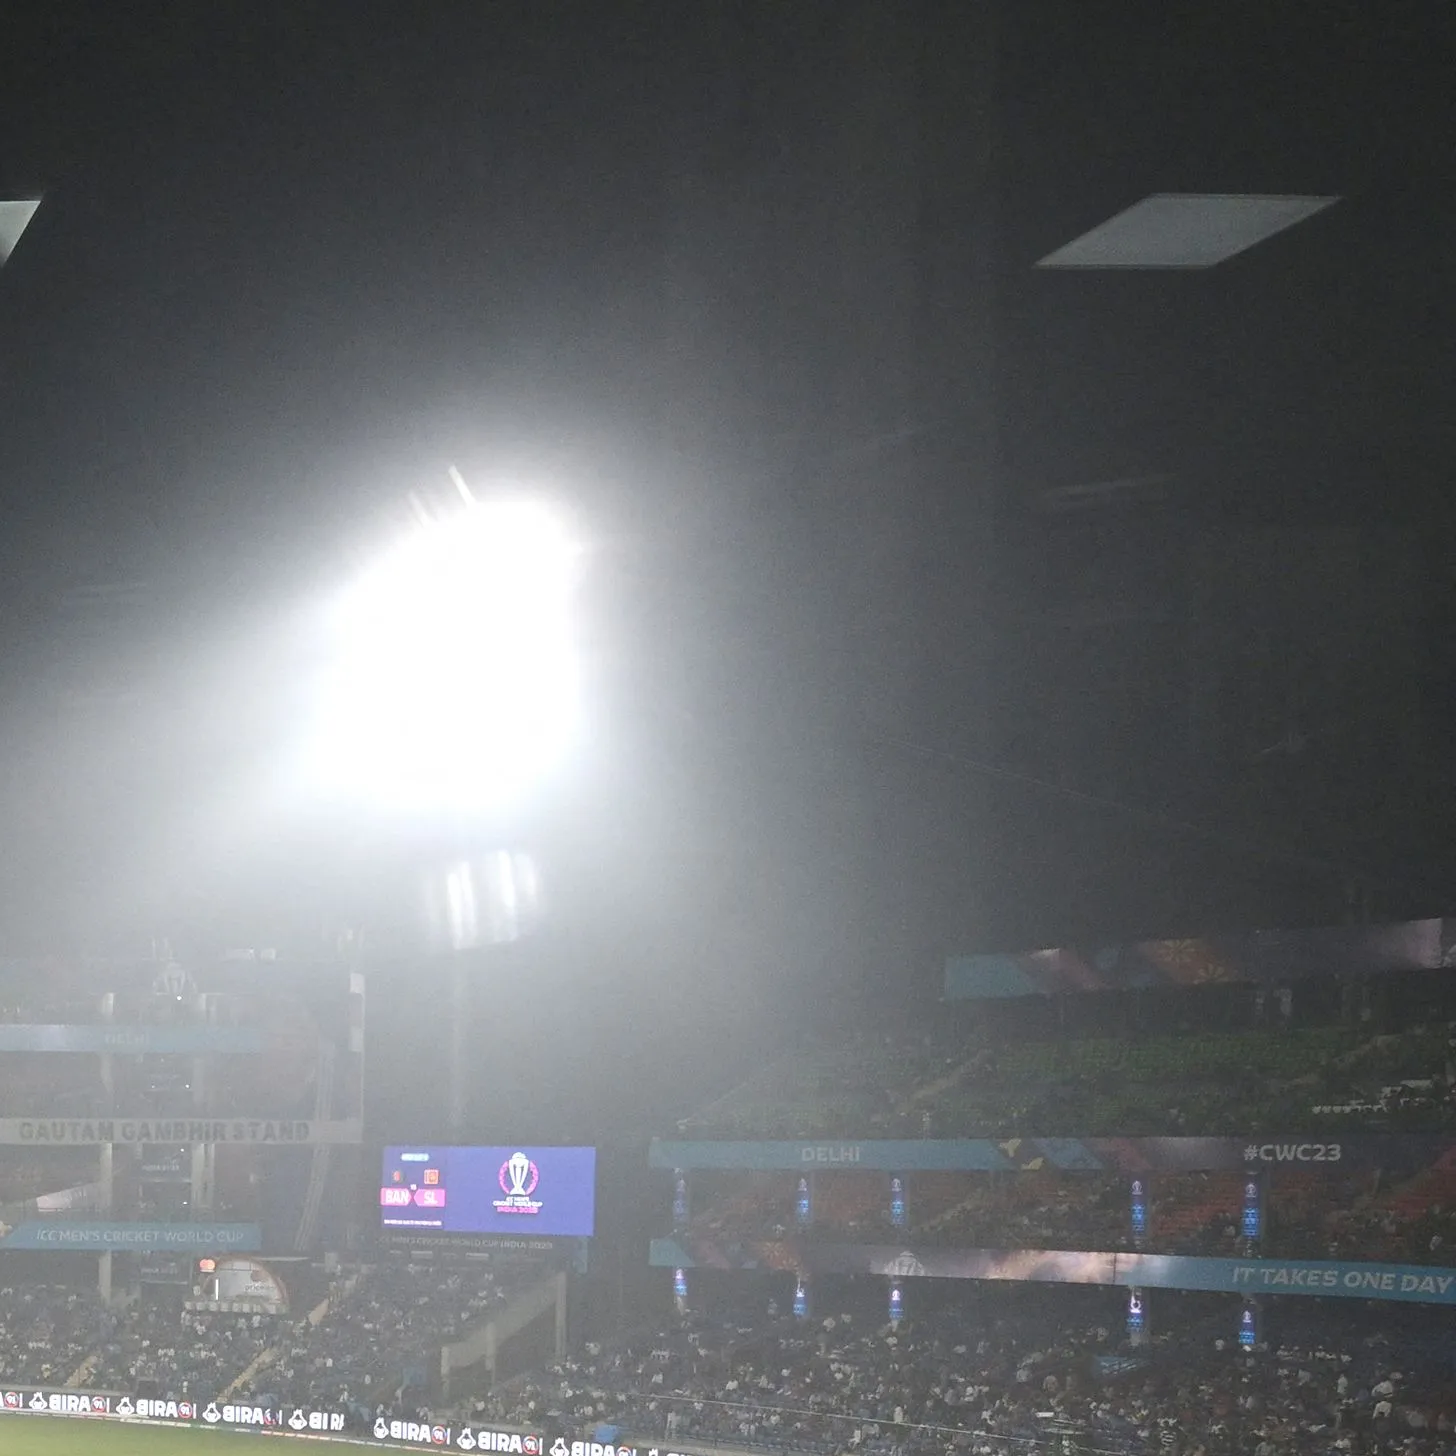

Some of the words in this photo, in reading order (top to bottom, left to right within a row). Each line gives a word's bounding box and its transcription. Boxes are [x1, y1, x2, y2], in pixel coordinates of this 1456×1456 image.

[19, 1122, 113, 1140] GAUTAM
[122, 1122, 225, 1141] GAMBHIR
[234, 1122, 309, 1142] STAND
[801, 1148, 860, 1162] DELHI
[1243, 1144, 1342, 1161] #CWC23
[37, 1230, 58, 1241] ICC
[60, 1230, 99, 1241] MEN'S
[104, 1230, 159, 1241] CRICKET
[164, 1231, 214, 1242] WORLD
[217, 1231, 243, 1242] CUP
[1231, 1268, 1256, 1283] IT
[1260, 1268, 1338, 1287] TAKES
[1343, 1271, 1395, 1290] ONE
[1401, 1275, 1453, 1294] DAY
[223, 1406, 264, 1424] BIRA
[391, 1421, 431, 1441] BIRA
[478, 1432, 522, 1452] BIRA
